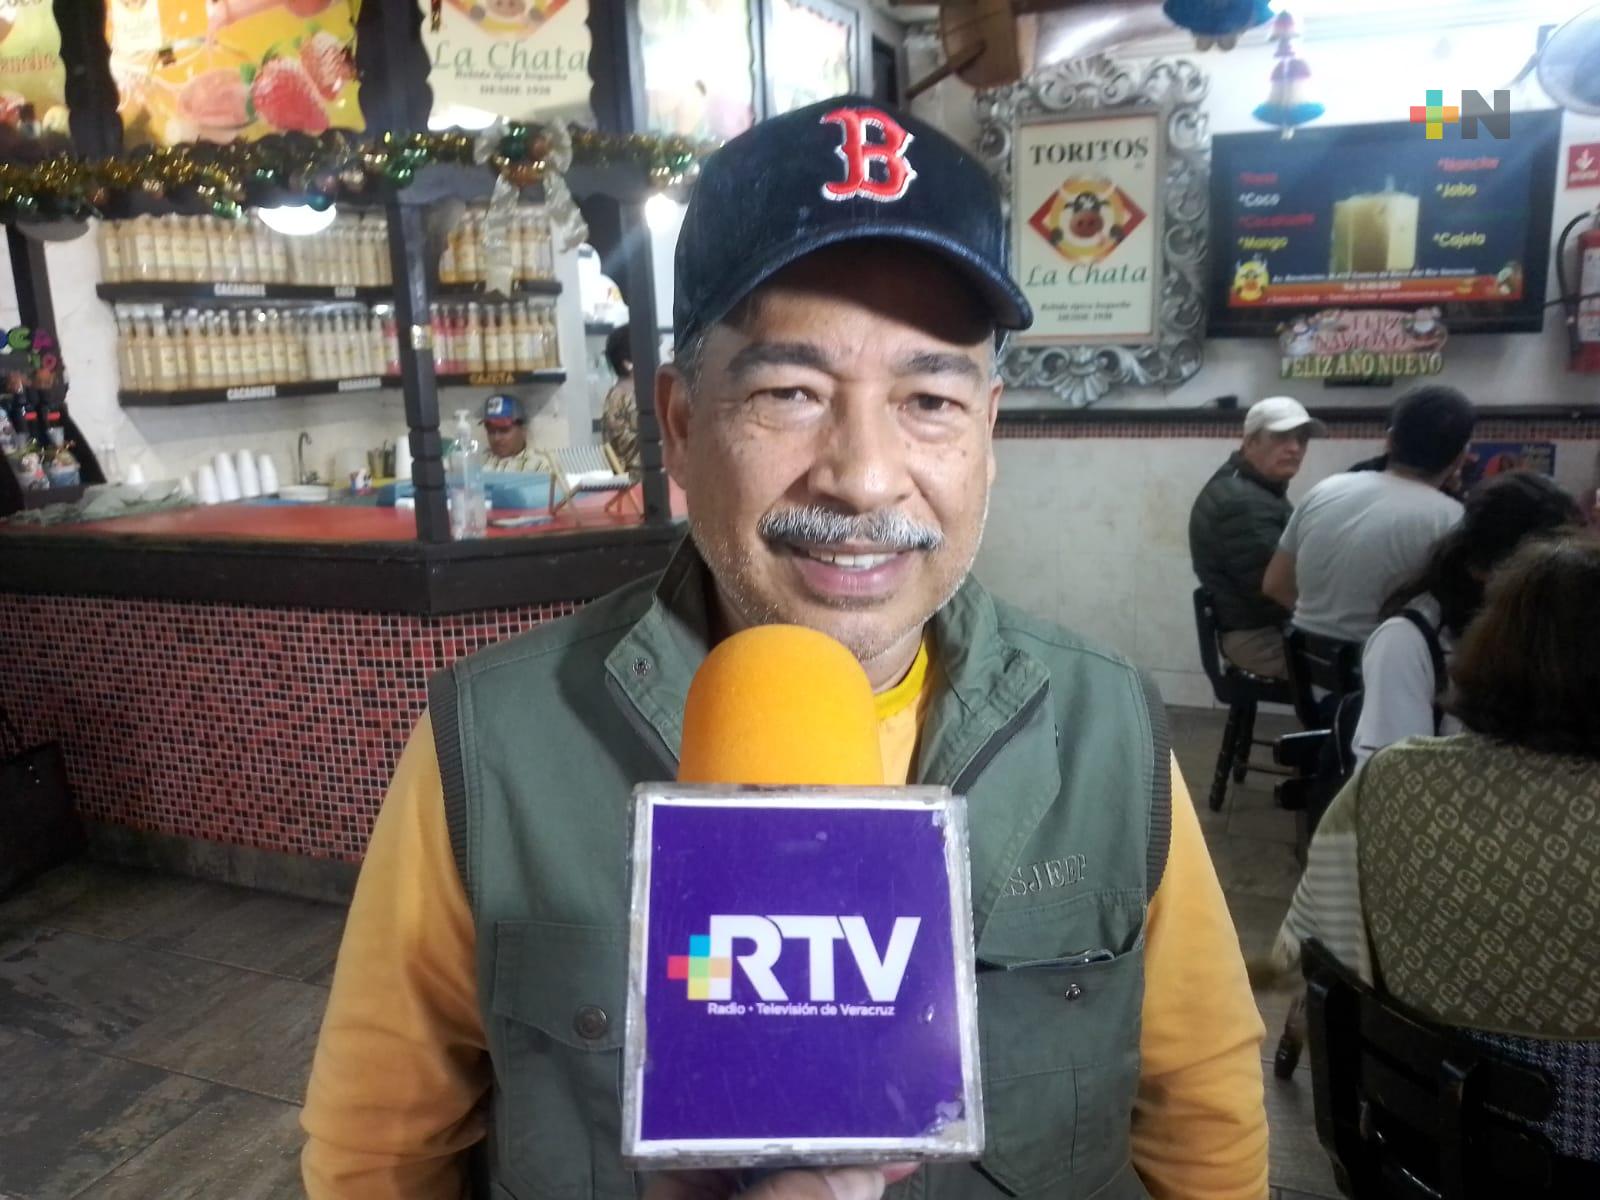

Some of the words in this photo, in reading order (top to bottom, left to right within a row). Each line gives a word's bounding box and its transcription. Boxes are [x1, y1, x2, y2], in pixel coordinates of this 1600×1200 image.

[431, 40, 474, 72] La
[488, 39, 586, 73] Chata
[819, 106, 918, 203] B
[1029, 136, 1150, 166] TORITOS
[1025, 264, 1058, 288] La
[1067, 262, 1148, 285] Chata
[1281, 355, 1334, 377] FELIZ
[1378, 350, 1443, 375] NUEVO
[709, 914, 922, 1002] RTV
[706, 1001, 746, 1016] Radio
[756, 1000, 819, 1018] Televisión
[820, 1001, 838, 1016] de
[840, 1003, 896, 1018] Veracruz
